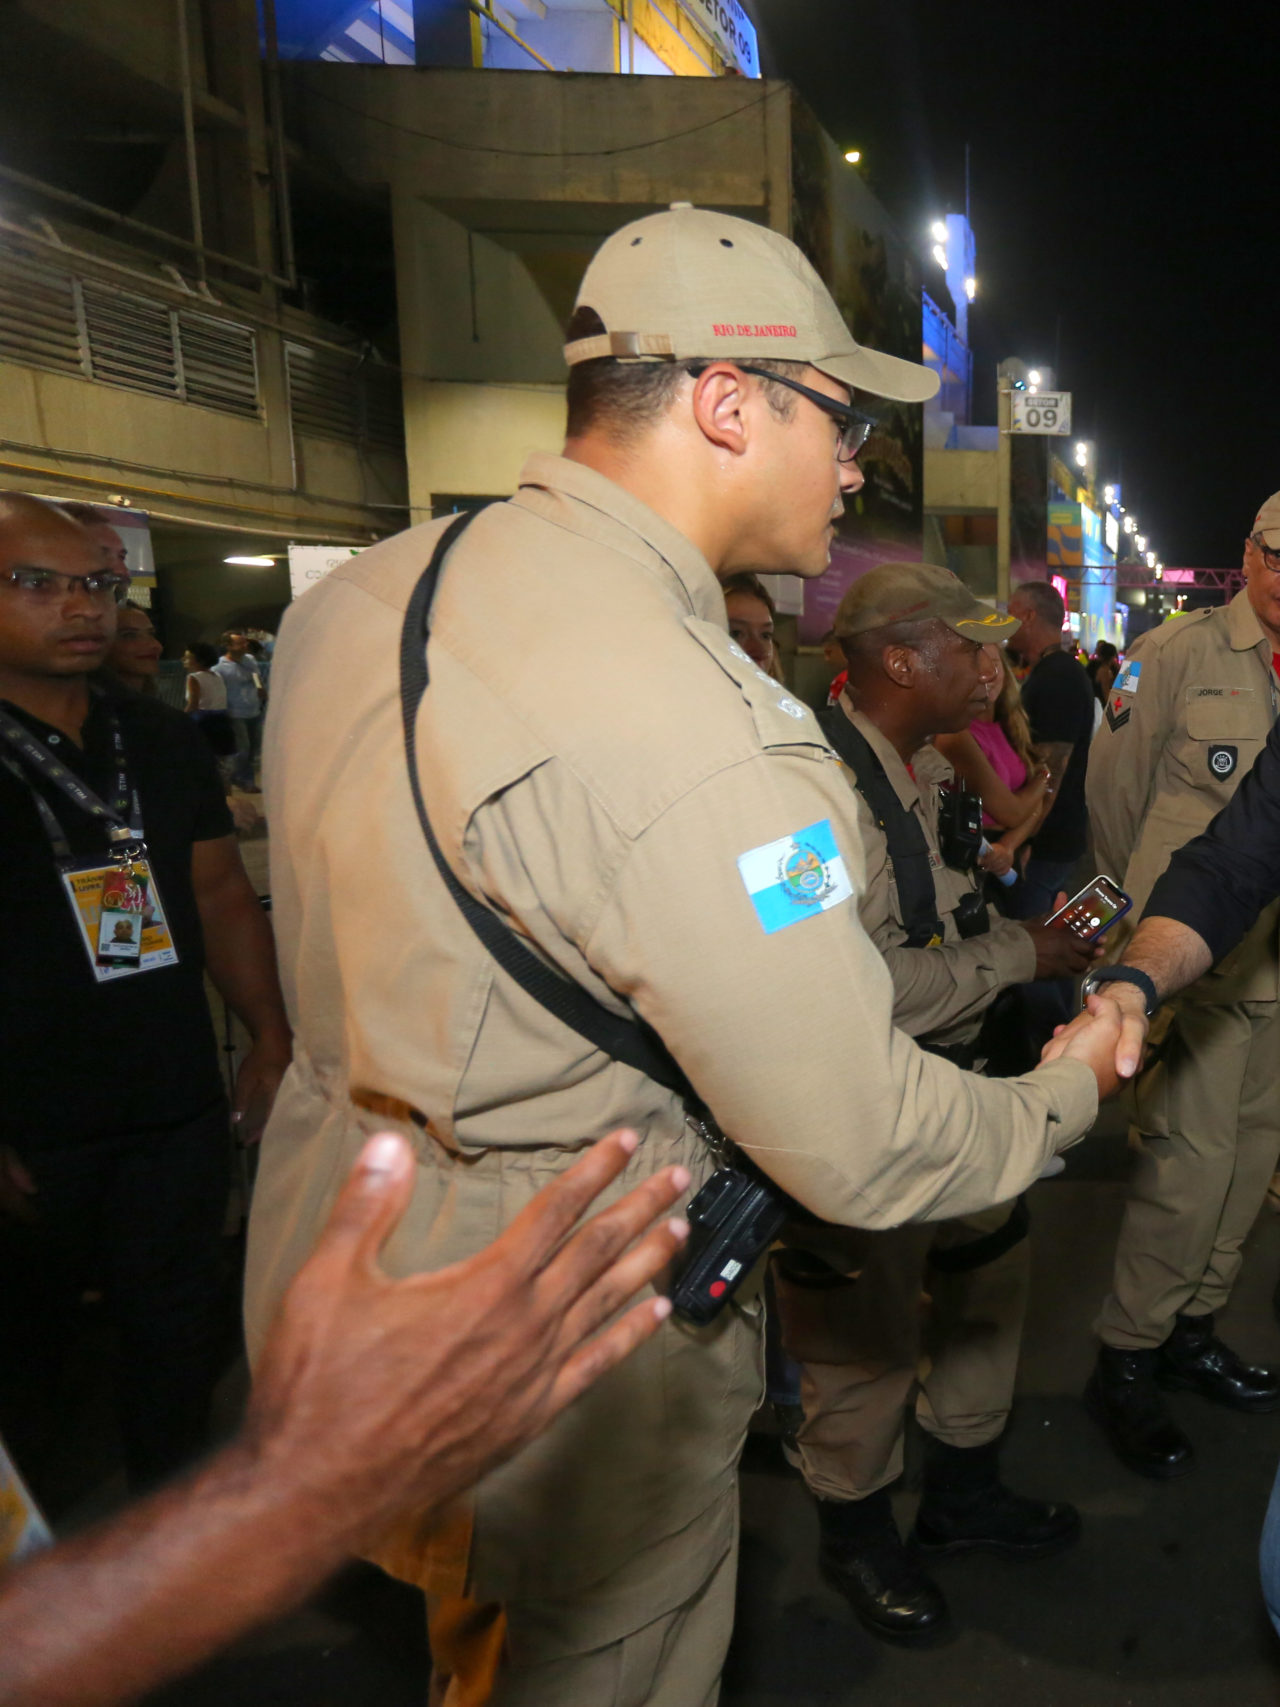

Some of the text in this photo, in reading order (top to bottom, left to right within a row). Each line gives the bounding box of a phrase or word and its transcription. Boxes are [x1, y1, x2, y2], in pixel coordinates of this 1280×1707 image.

[701, 0, 737, 45] ETOR
[712, 323, 797, 337] RIO DE JANEIRO
[1026, 409, 1058, 428] 09
[1198, 688, 1224, 697] JORGE
